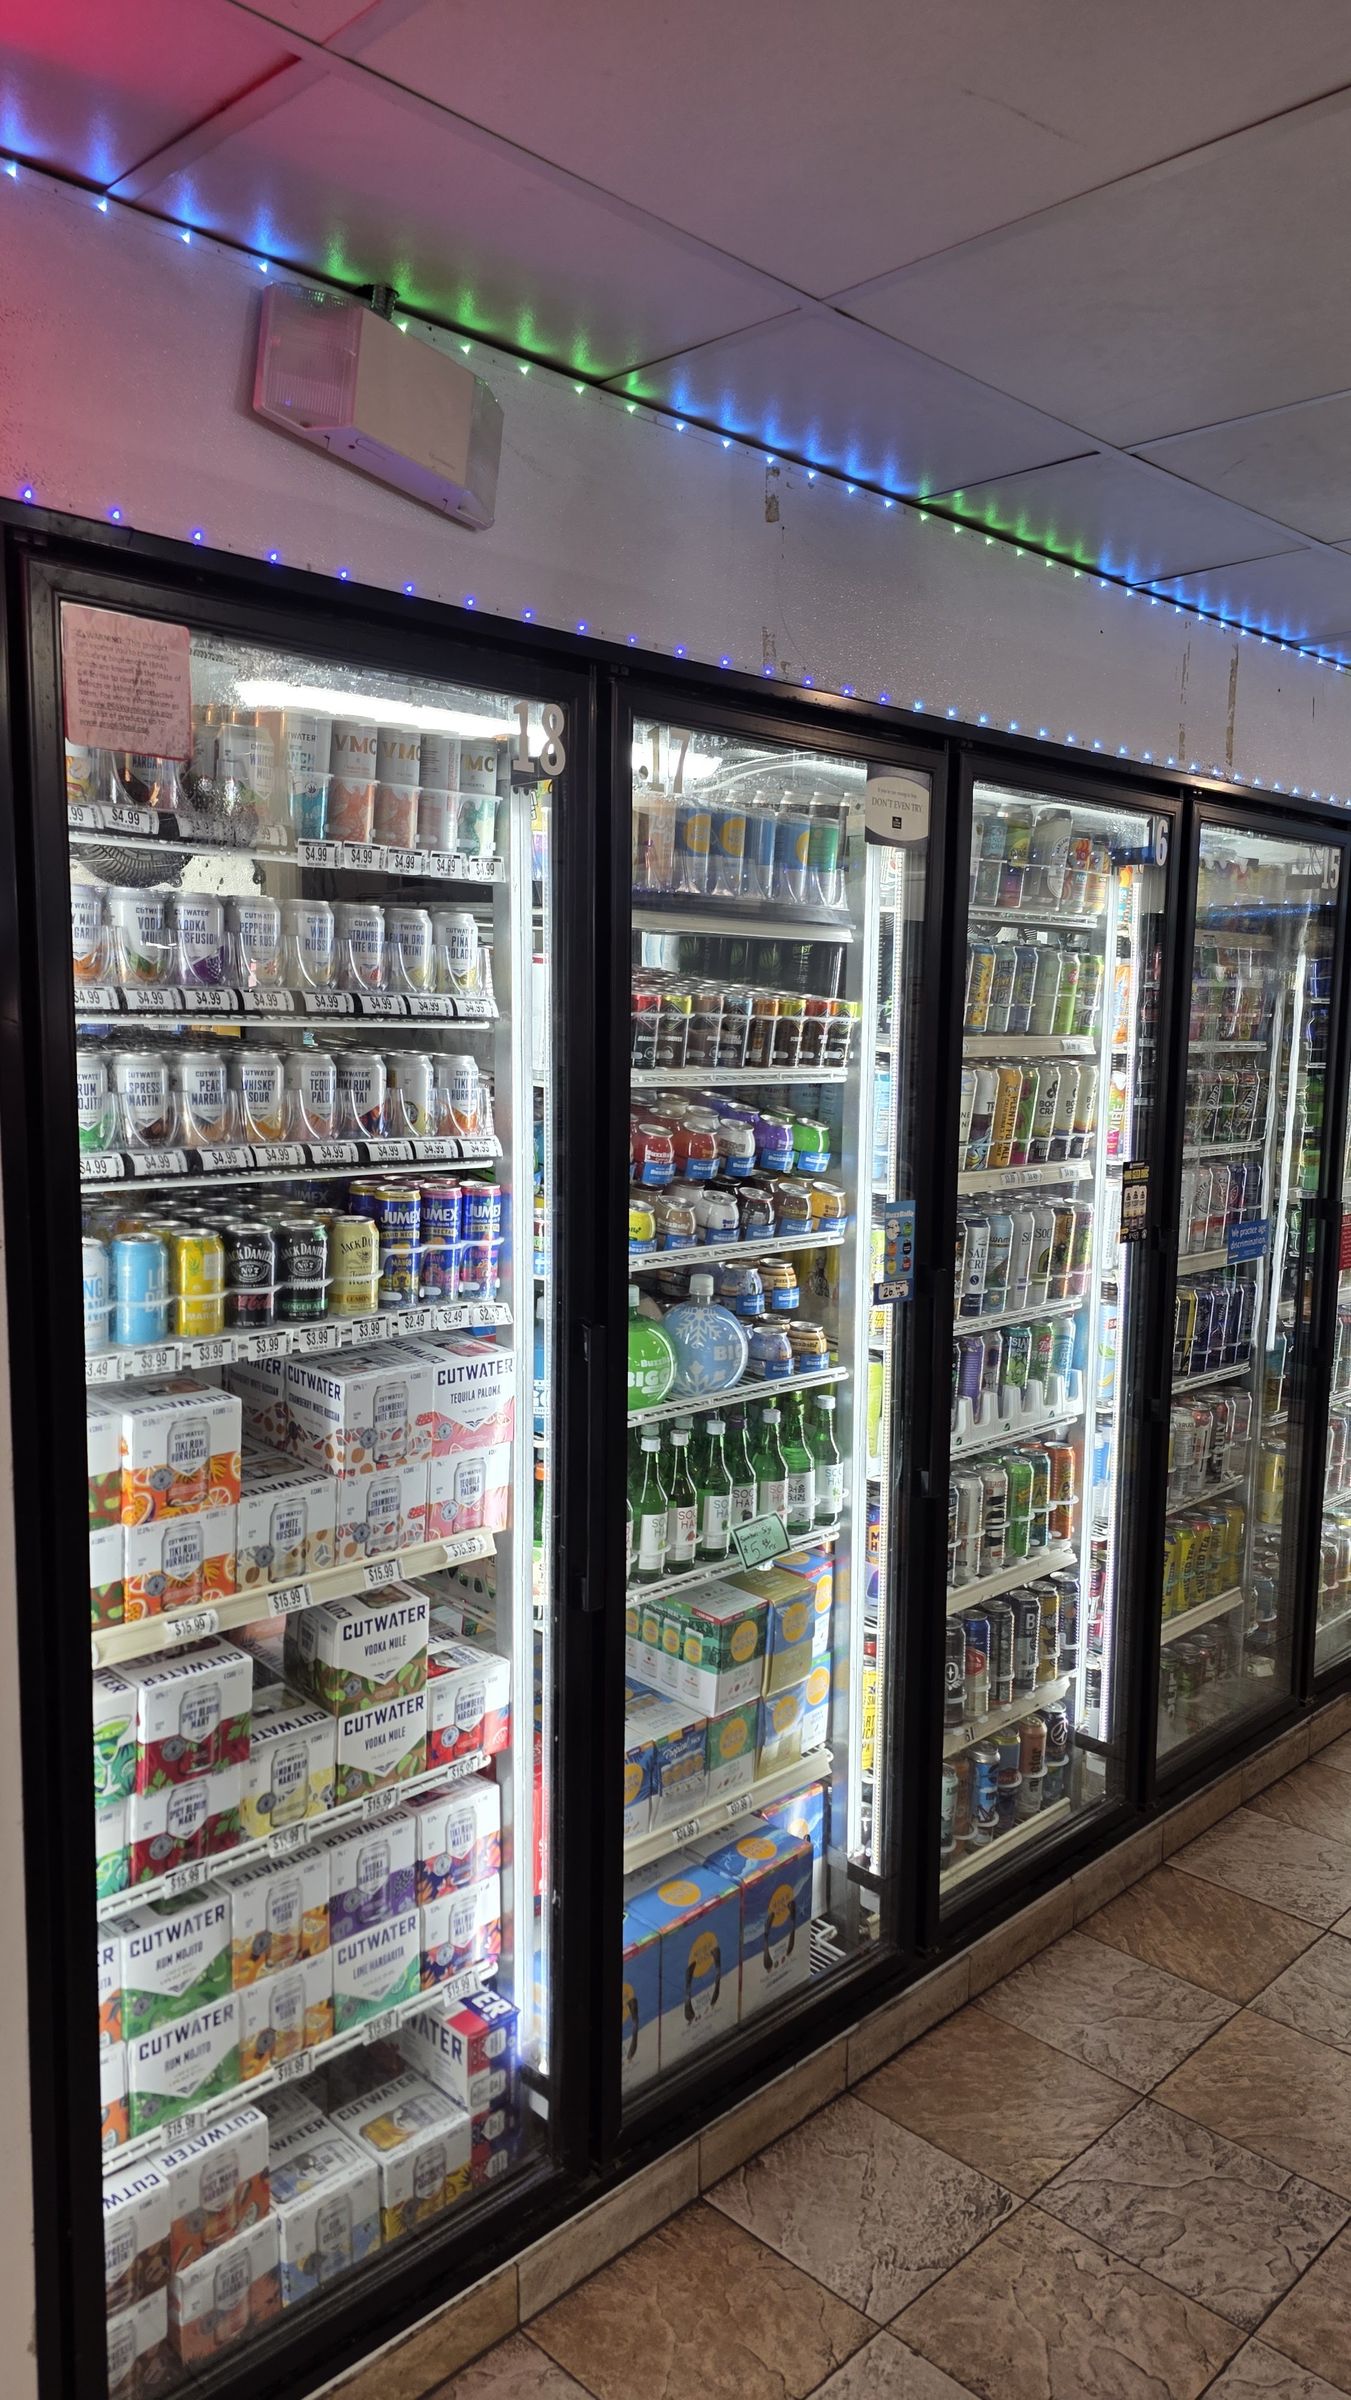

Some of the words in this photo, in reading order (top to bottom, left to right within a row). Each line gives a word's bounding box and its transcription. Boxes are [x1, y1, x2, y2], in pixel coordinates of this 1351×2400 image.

[512, 699, 566, 776] 18
[648, 726, 691, 795] 17
[112, 808, 140, 825] $4.99
[306, 847, 327, 862] $4.99
[351, 850, 373, 864] $4.99
[394, 854, 415, 869] $4.99
[1321, 849, 1340, 890] 15
[137, 992, 164, 1005] $4.99
[196, 992, 221, 1005] $4.99
[255, 993, 278, 1006] $4.99
[316, 994, 339, 1008] $4.99
[369, 996, 392, 1009] $4.99
[248, 1092, 270, 1103] SOUR
[213, 1151, 238, 1165] $4.99
[266, 1148, 290, 1162] $4.99
[322, 1145, 344, 1159] $4.99
[378, 1144, 399, 1157] $4.99
[145, 1155, 171, 1169] $4.99
[404, 1315, 425, 1329] $2.49
[443, 1311, 463, 1324] $2.49
[306, 1330, 328, 1345] $3.99
[359, 1322, 380, 1336] $3.99
[199, 1345, 224, 1360] $3.99
[256, 1339, 279, 1354] $3.99
[141, 1354, 167, 1368] $3.99
[437, 1359, 514, 1386] CUTWATER
[287, 1365, 341, 1401] CUTWATER
[450, 1390, 476, 1405] TEQUILA
[477, 1384, 502, 1399] PALOMA
[459, 1476, 481, 1490] TEQUILA
[453, 1540, 476, 1558] $15.99
[369, 1565, 394, 1582] $15.99
[273, 1590, 301, 1609] $15.99
[175, 1619, 206, 1637] $15.99
[343, 1604, 427, 1641] CUTWATER
[364, 1642, 387, 1657] VODKA
[389, 1635, 408, 1649] MULE
[143, 1652, 245, 1687] CUTWATER
[344, 1694, 425, 1737] CUTWATER
[365, 1735, 387, 1750] VODKA
[389, 1726, 407, 1740] MULE
[324, 1812, 408, 1849] CUTWATER
[129, 1904, 225, 1958] CUTWATER
[338, 1915, 417, 1965] CUTWATER
[156, 1954, 174, 1971] RUM
[175, 1941, 204, 1964] MOJITO
[139, 2003, 235, 2061] CUTWATER
[164, 2055, 182, 2073] RUM
[183, 2041, 212, 2064] MOJITO
[336, 2072, 420, 2122] CUTWATER
[162, 2110, 261, 2168] CUTWATER
